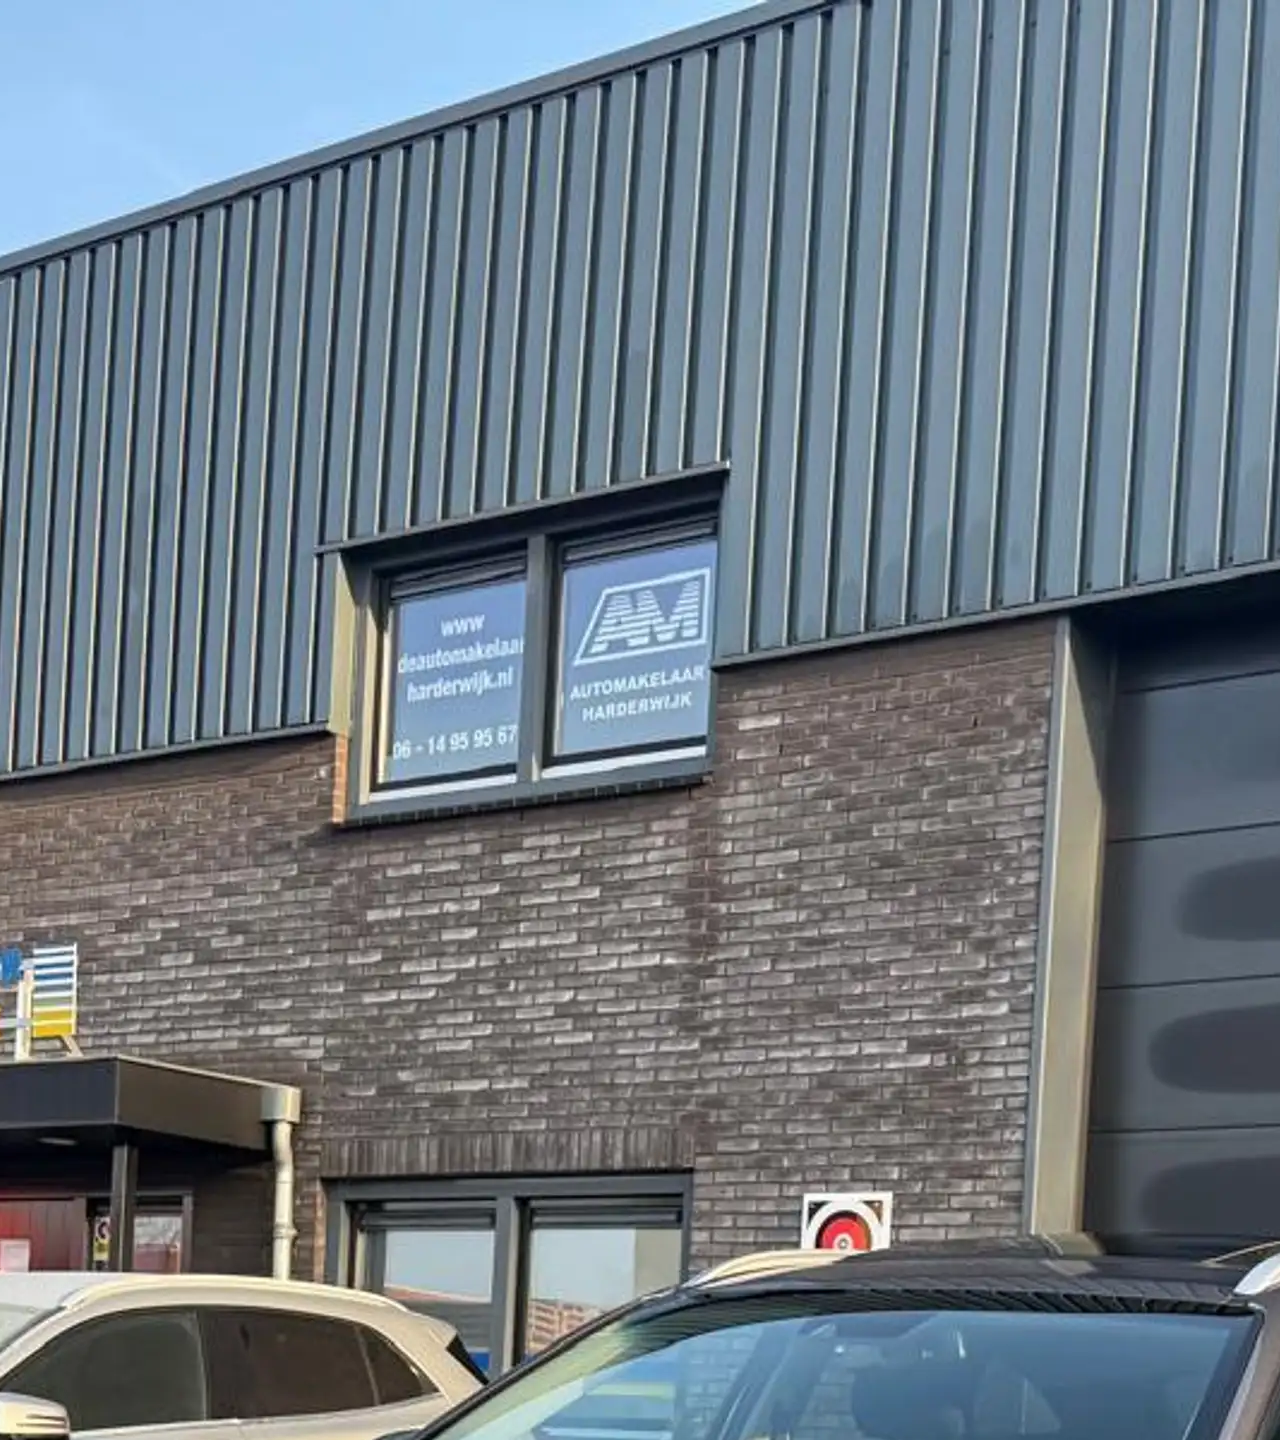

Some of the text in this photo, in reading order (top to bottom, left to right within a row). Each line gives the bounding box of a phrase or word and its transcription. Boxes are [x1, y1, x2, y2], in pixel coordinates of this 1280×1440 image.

[441, 614, 485, 637] www
[407, 665, 513, 702] harderwijk.nl
[570, 664, 705, 700] AUTOMAKELAAR
[582, 691, 692, 722] HARDERWIJK
[393, 739, 411, 760] 06
[428, 734, 445, 755] 14
[450, 732, 468, 751] 95
[474, 727, 492, 748] 95
[498, 724, 518, 745] 67
